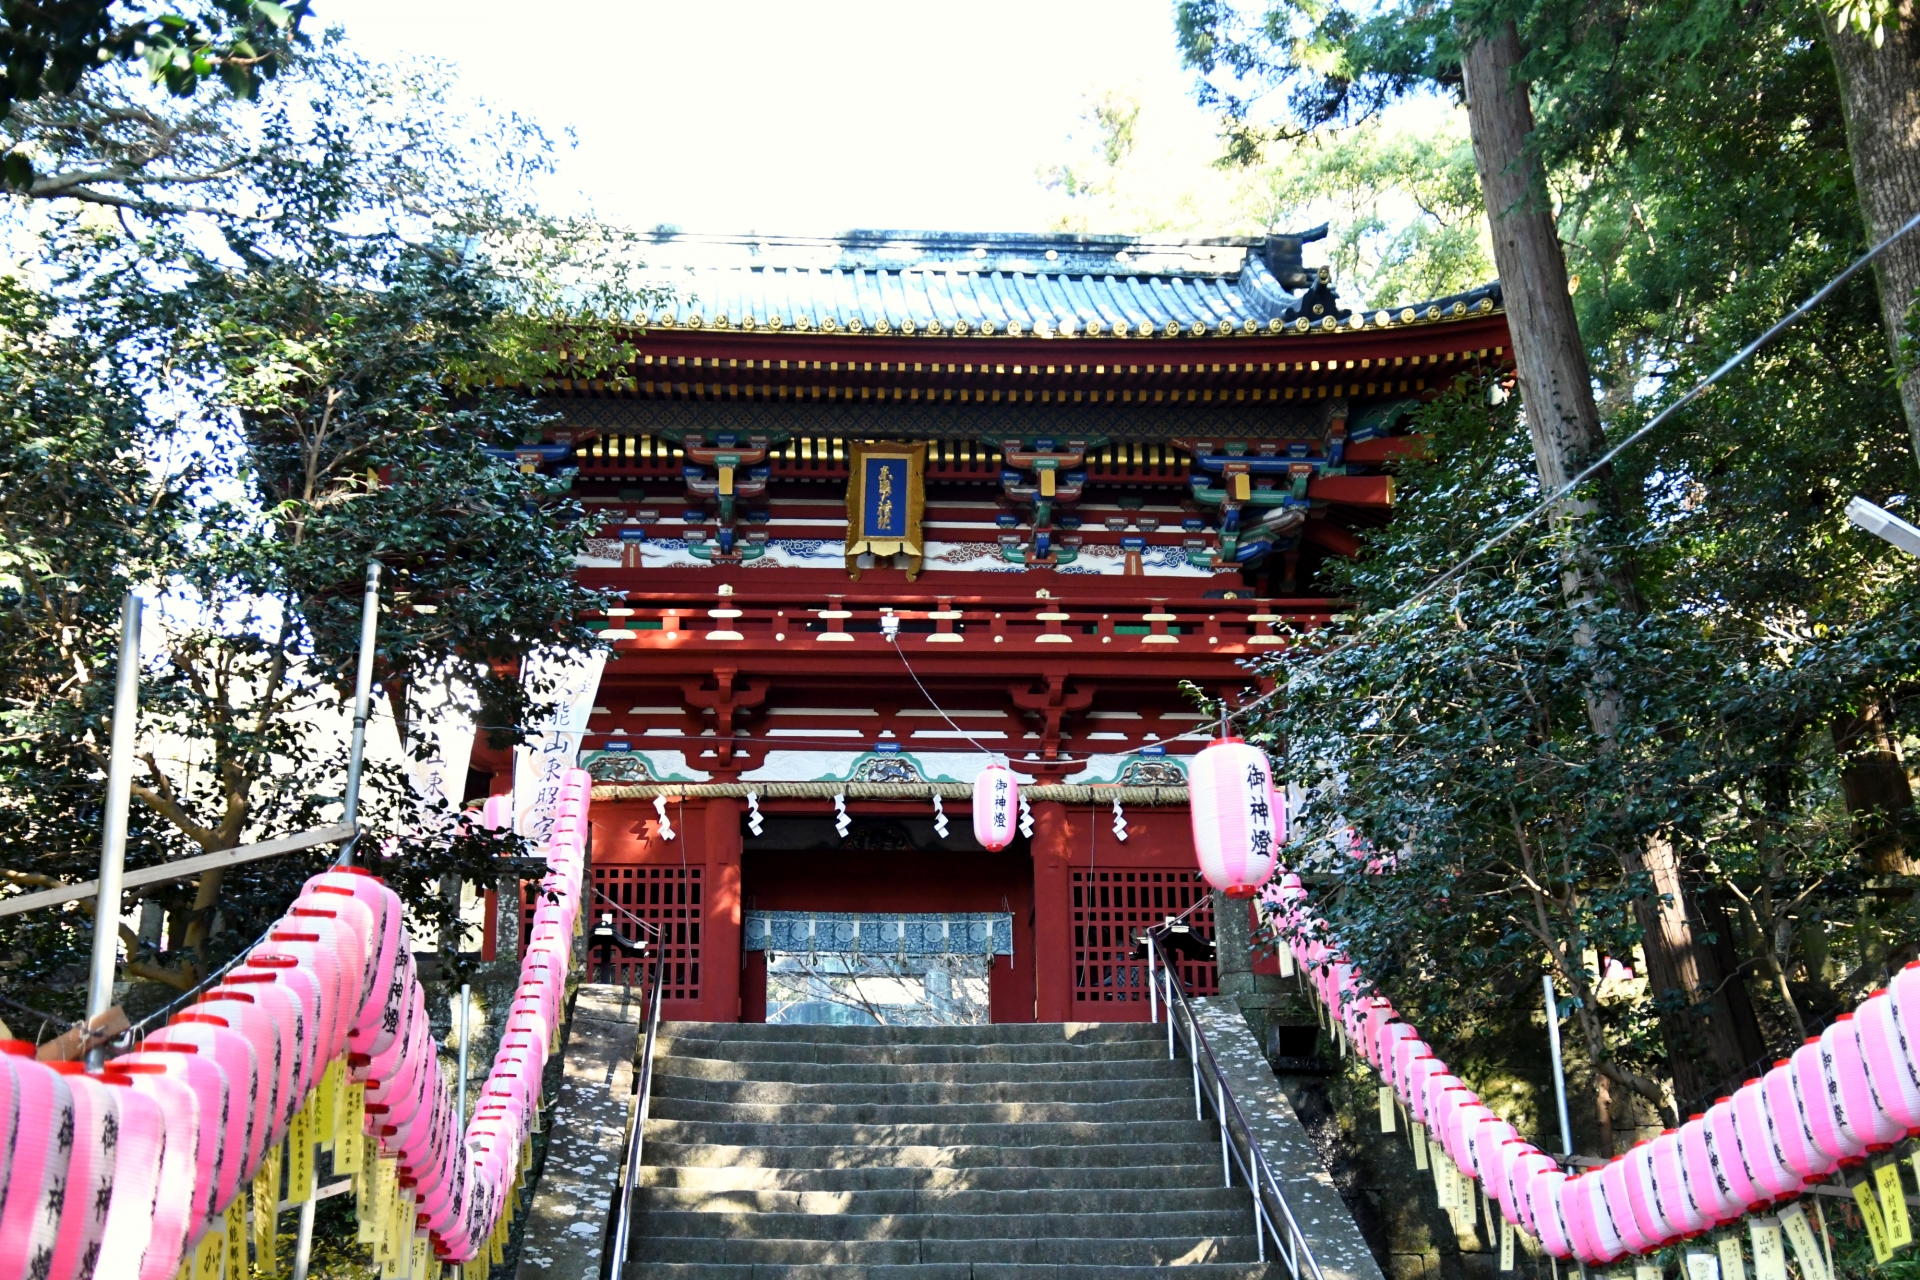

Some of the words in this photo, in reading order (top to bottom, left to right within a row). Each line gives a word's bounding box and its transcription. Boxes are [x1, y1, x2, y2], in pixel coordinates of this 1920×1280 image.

[533, 672, 573, 845] 久能山東照宮
[993, 778, 1008, 828] 御神燈
[1246, 762, 1273, 857] 御神燈
[1883, 1178, 1902, 1240] 中村農園
